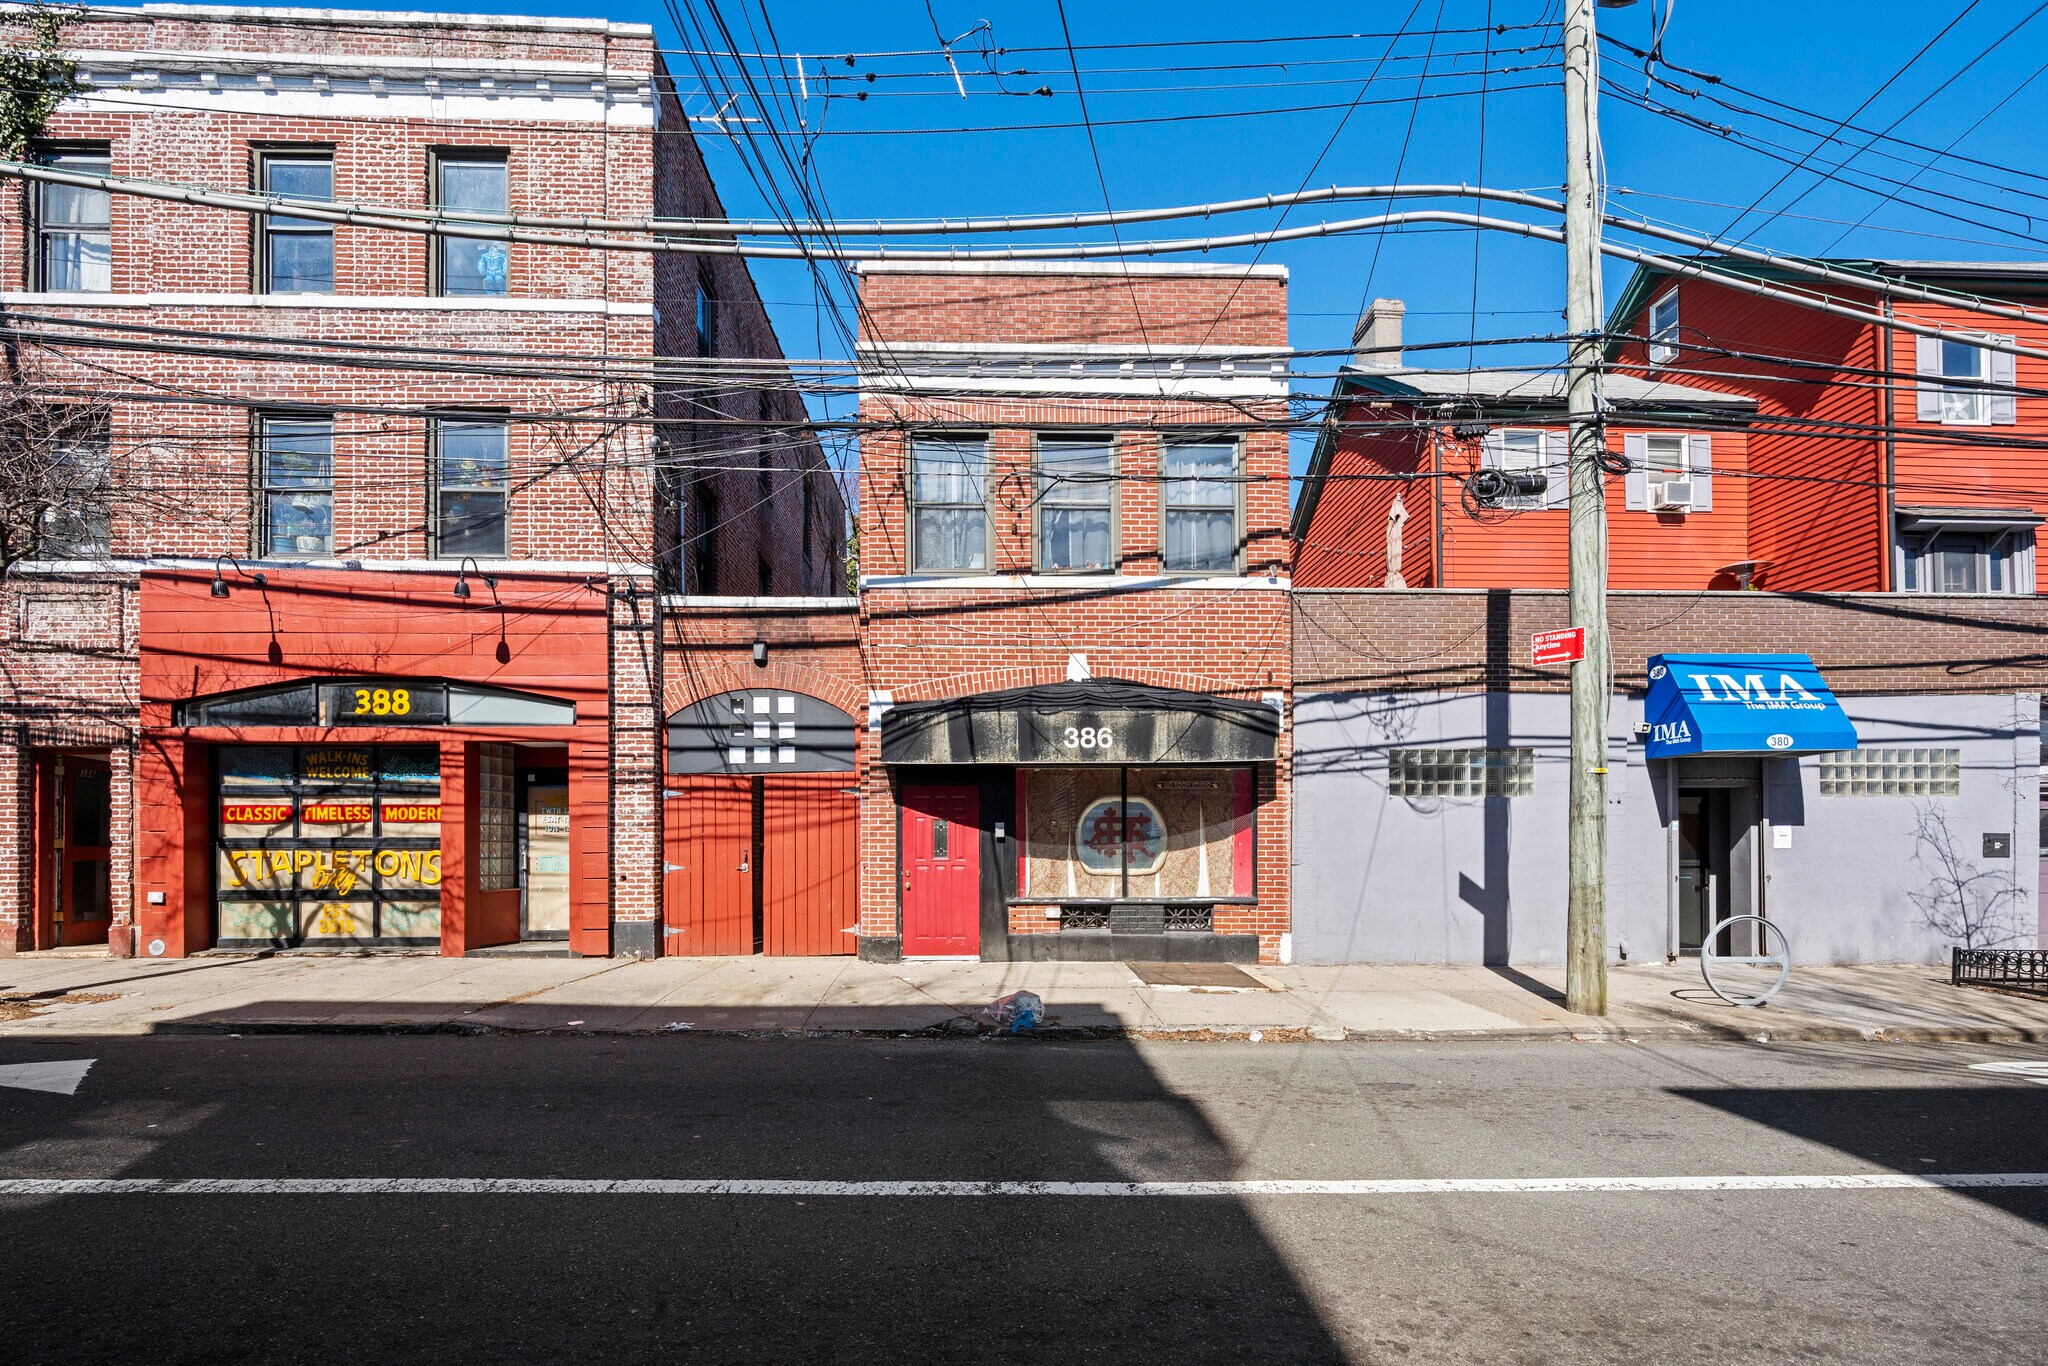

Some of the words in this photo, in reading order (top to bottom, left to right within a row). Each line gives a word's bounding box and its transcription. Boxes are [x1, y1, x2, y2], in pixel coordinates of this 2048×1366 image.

[1545, 631, 1576, 642] STANDING
[1536, 642, 1561, 651] Anytime
[1652, 666, 1664, 678] 380
[1687, 674, 1822, 701] IMA
[355, 688, 410, 715] 388
[1743, 701, 1766, 710] The
[1766, 701, 1790, 710] IMA
[1790, 701, 1826, 711] Group
[1064, 727, 1113, 749] 386
[1653, 720, 1691, 741] IMA
[1771, 736, 1789, 747] 380
[306, 751, 369, 766] WALK-INS
[306, 766, 369, 778] WELCOME
[226, 807, 287, 821] CLASSIC
[303, 806, 371, 821] TIMELESS
[228, 849, 441, 887] STAPLETONS
[322, 903, 351, 918] EST
[319, 919, 356, 934] 2015
